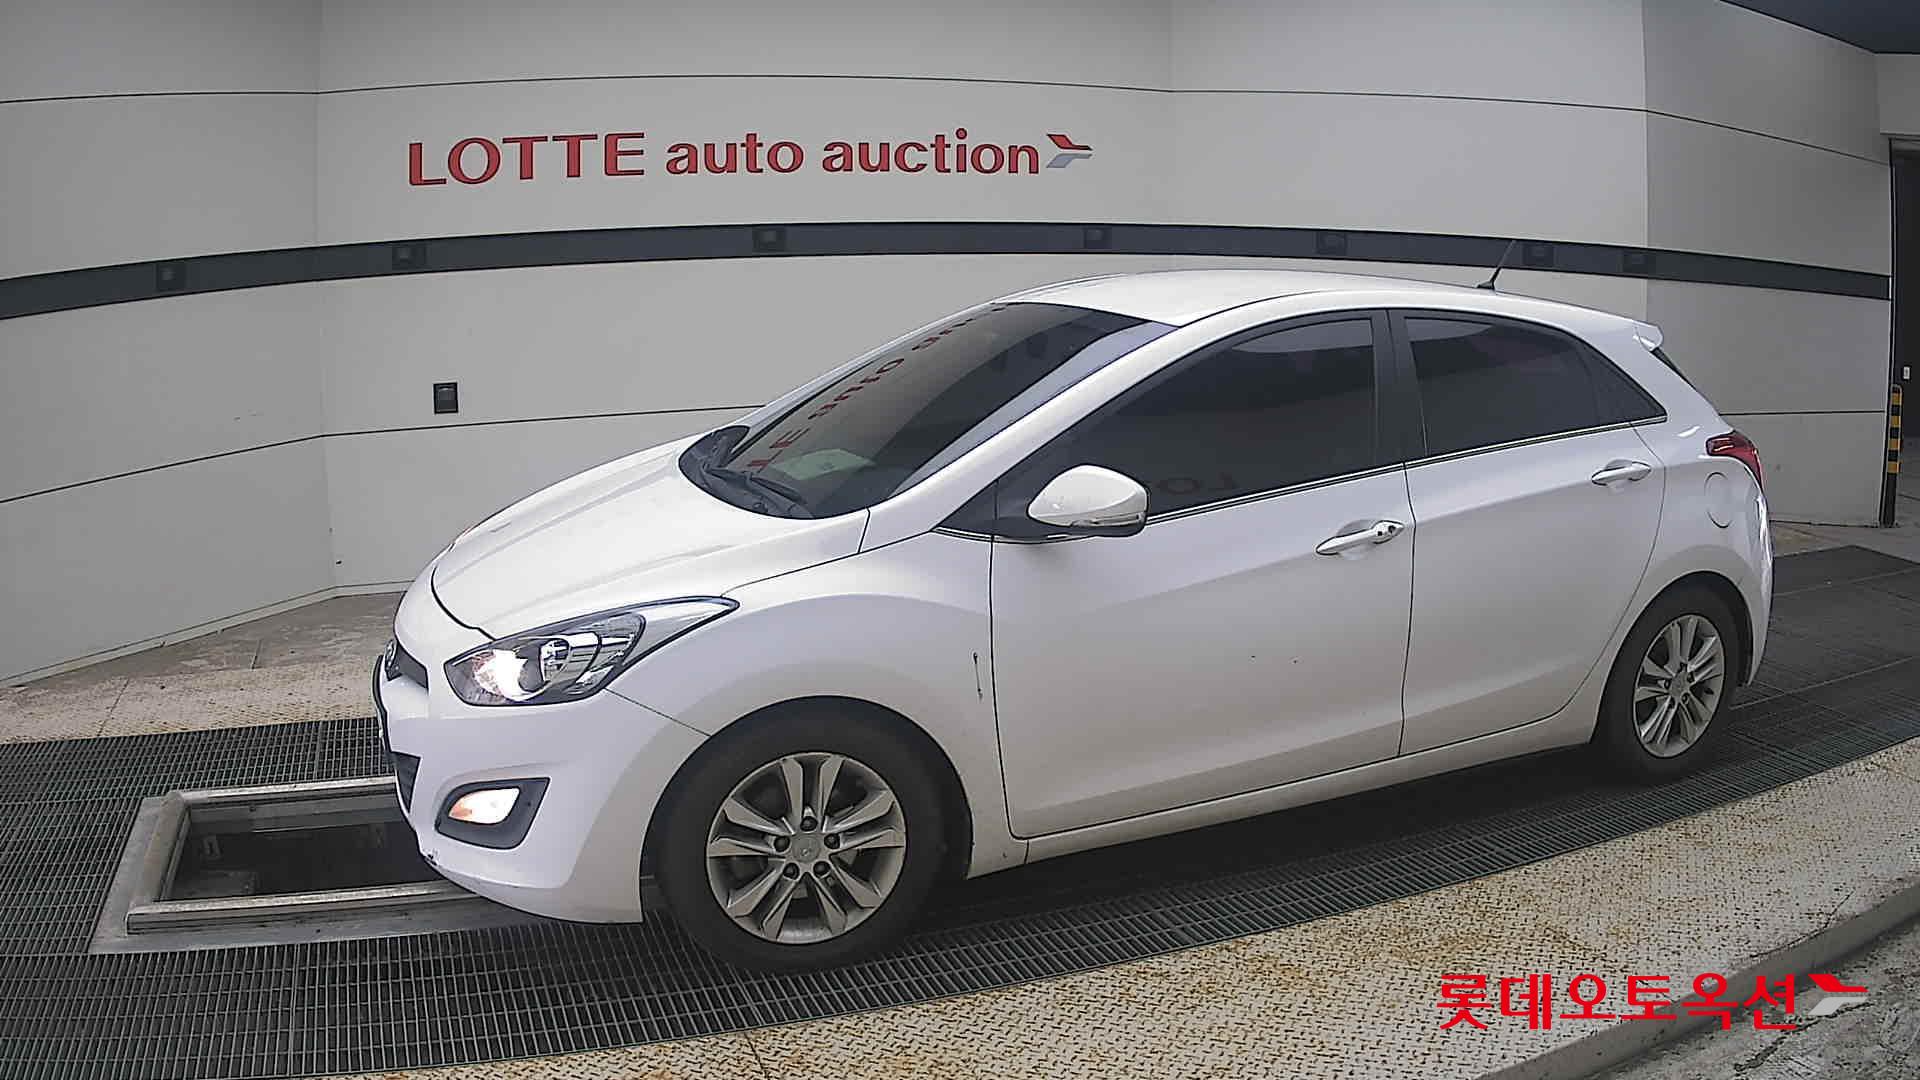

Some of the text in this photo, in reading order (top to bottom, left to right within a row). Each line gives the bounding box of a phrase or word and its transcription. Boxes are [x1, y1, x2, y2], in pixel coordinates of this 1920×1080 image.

[408, 127, 1041, 187] LOTTE auto auction
